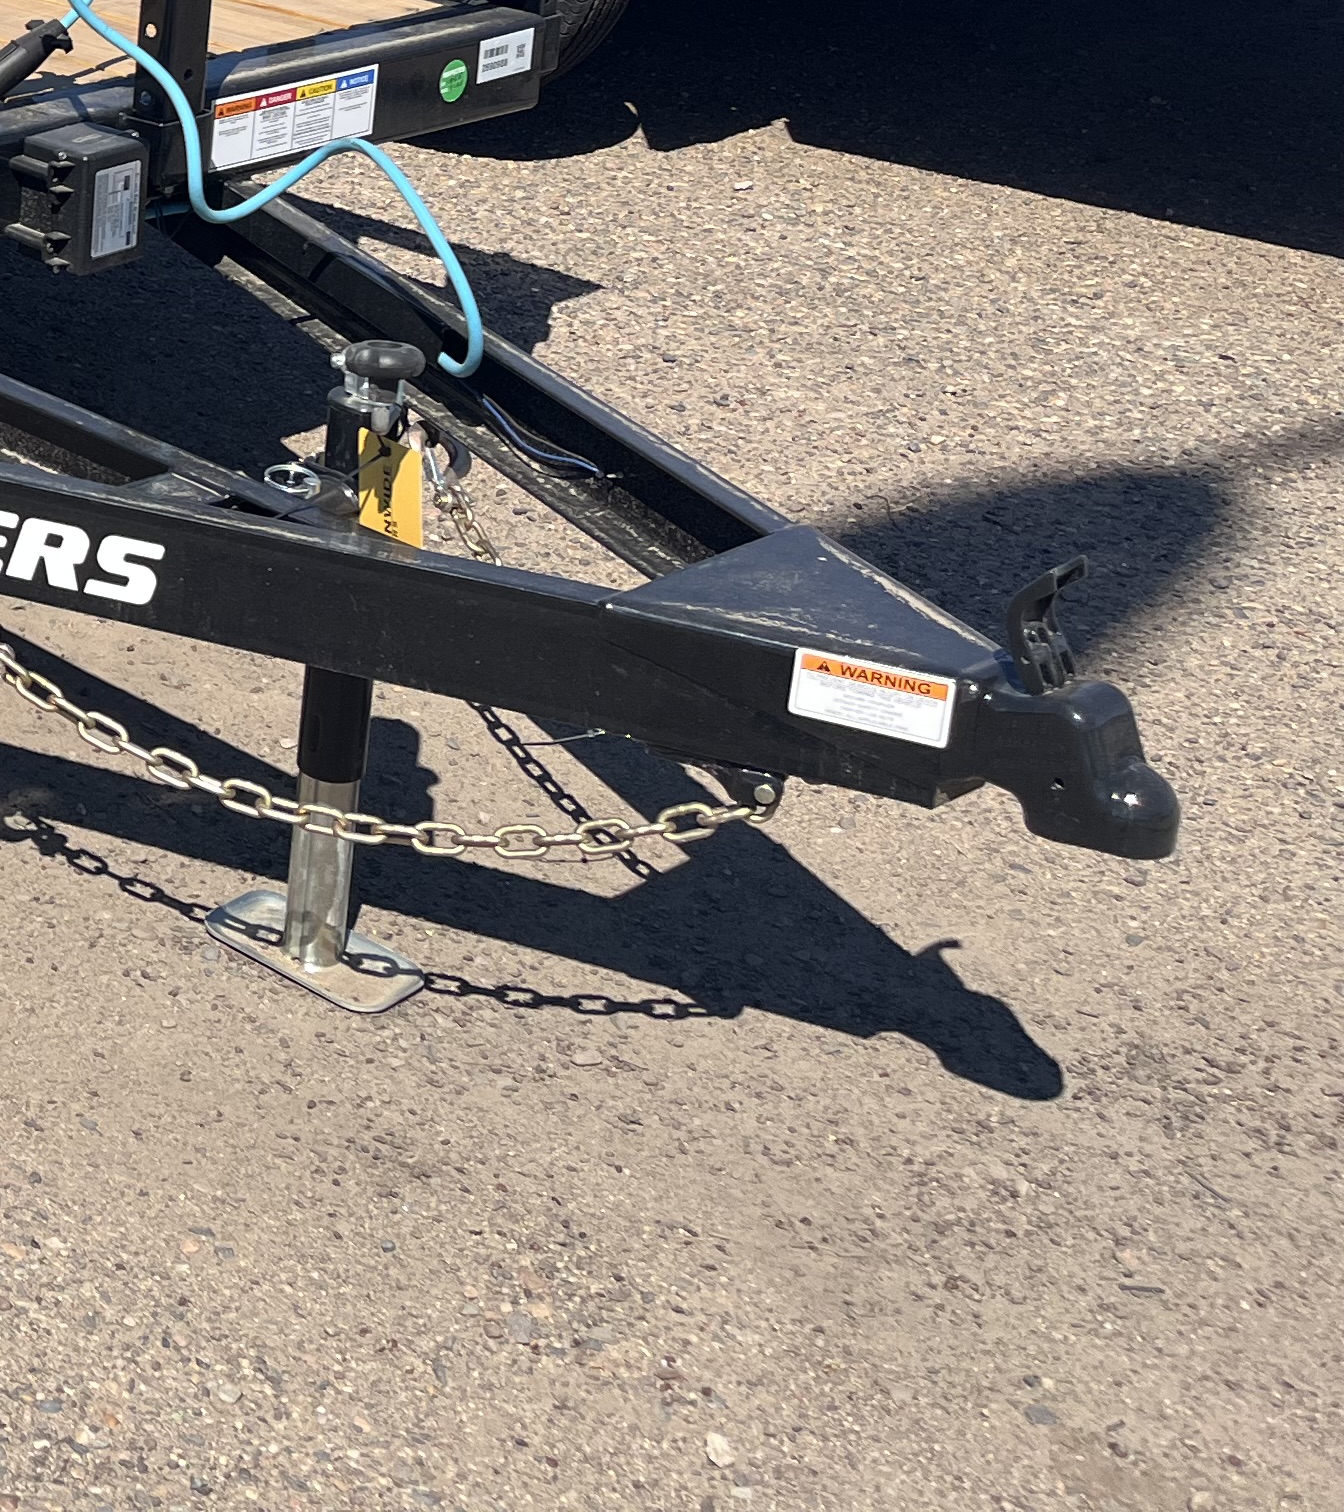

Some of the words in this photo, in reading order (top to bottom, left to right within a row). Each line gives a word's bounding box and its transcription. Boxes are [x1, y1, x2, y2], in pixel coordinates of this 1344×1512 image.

[349, 74, 369, 86] NOTICE
[308, 83, 333, 95] CAUTION
[268, 92, 293, 104] DANGER
[839, 661, 931, 696] WARNING
